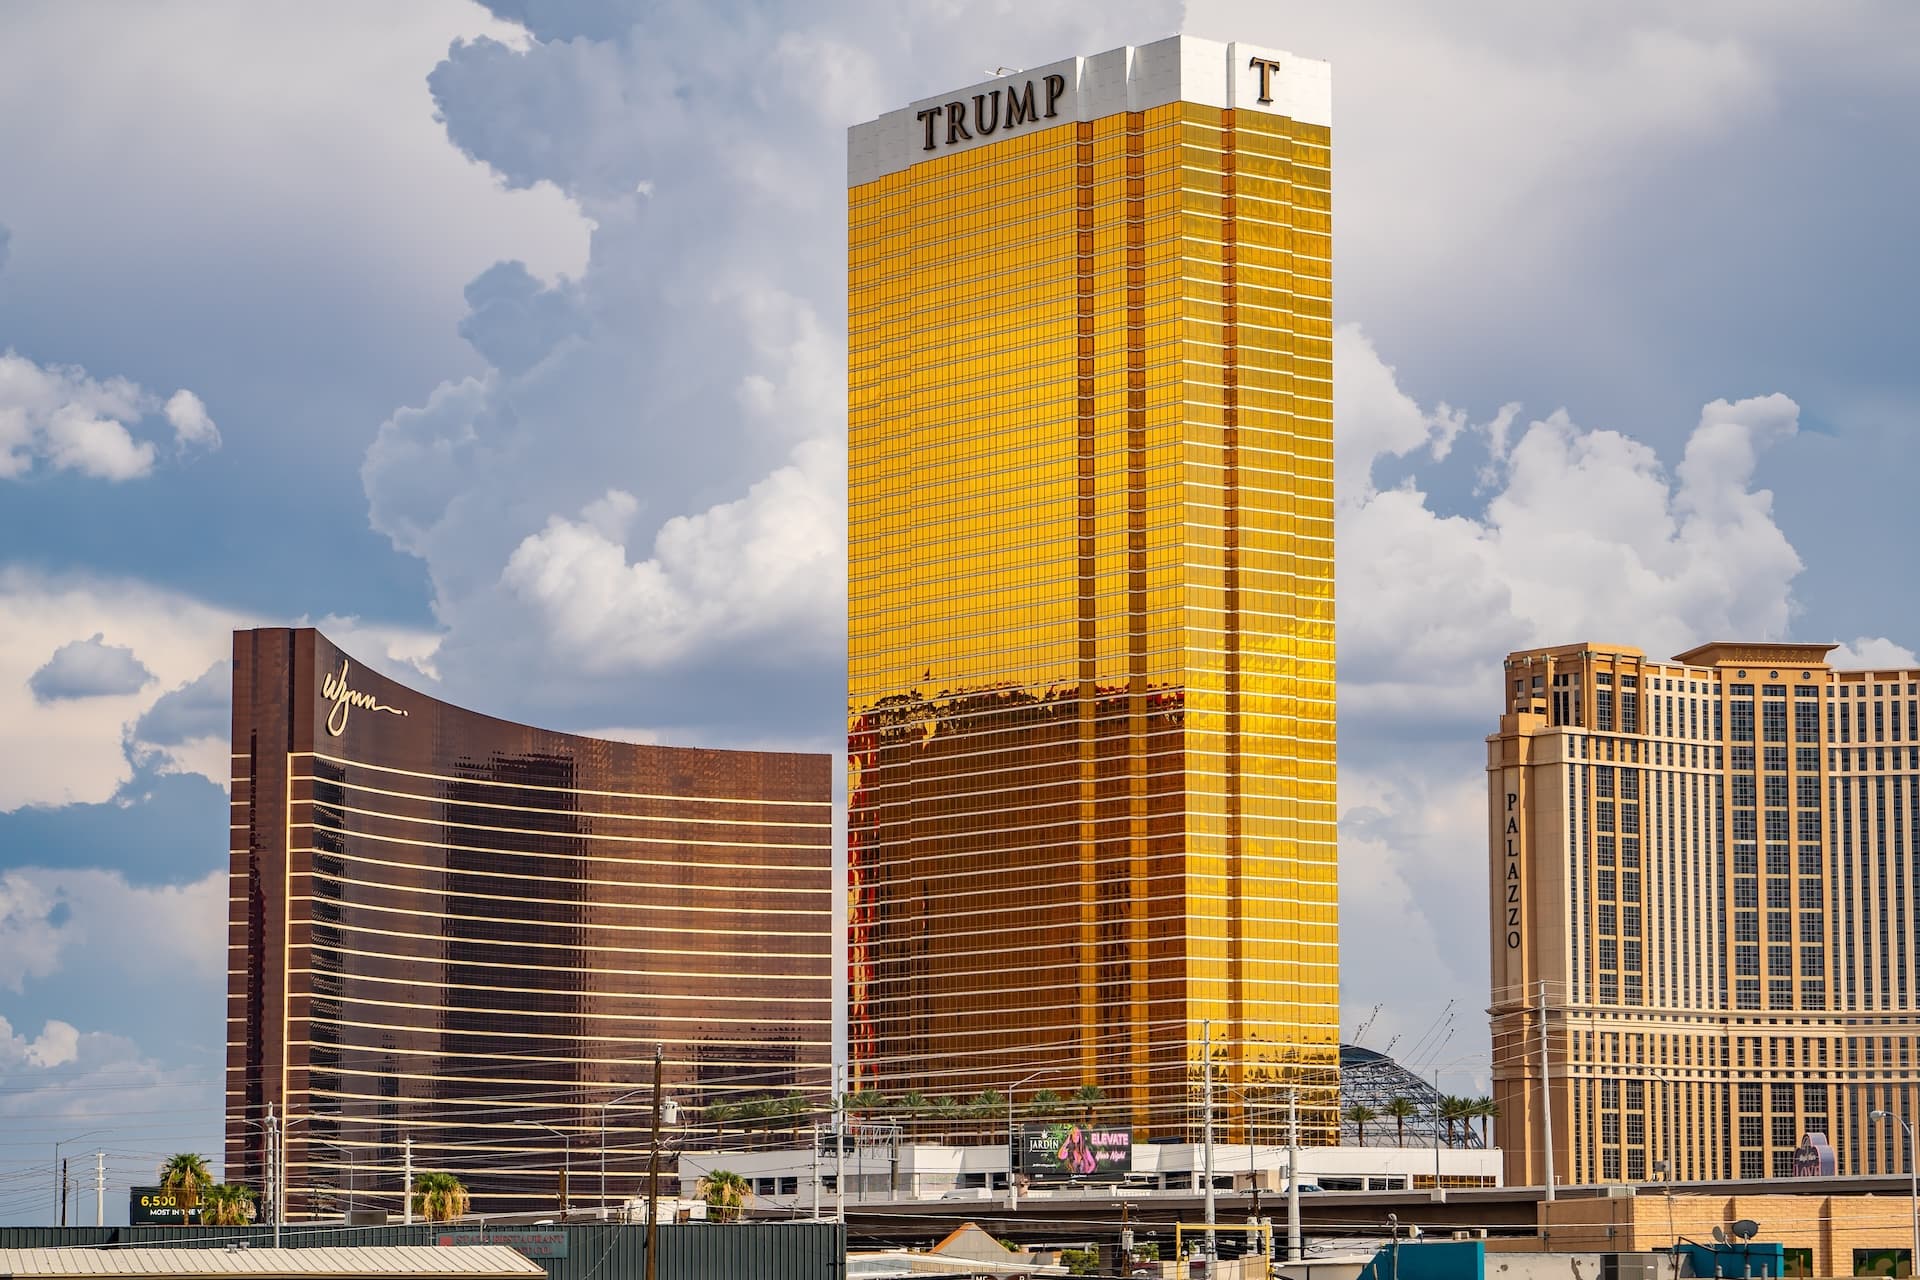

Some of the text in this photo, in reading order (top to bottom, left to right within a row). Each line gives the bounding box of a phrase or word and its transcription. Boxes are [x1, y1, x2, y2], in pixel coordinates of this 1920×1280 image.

[1249, 56, 1280, 103] T
[917, 74, 1065, 150] TRUMP
[1734, 648, 1812, 660] PALAZZO
[1506, 793, 1520, 949] PALAZZO
[1091, 1133, 1129, 1146] ELEVATE
[141, 1195, 177, 1207] 6,500
